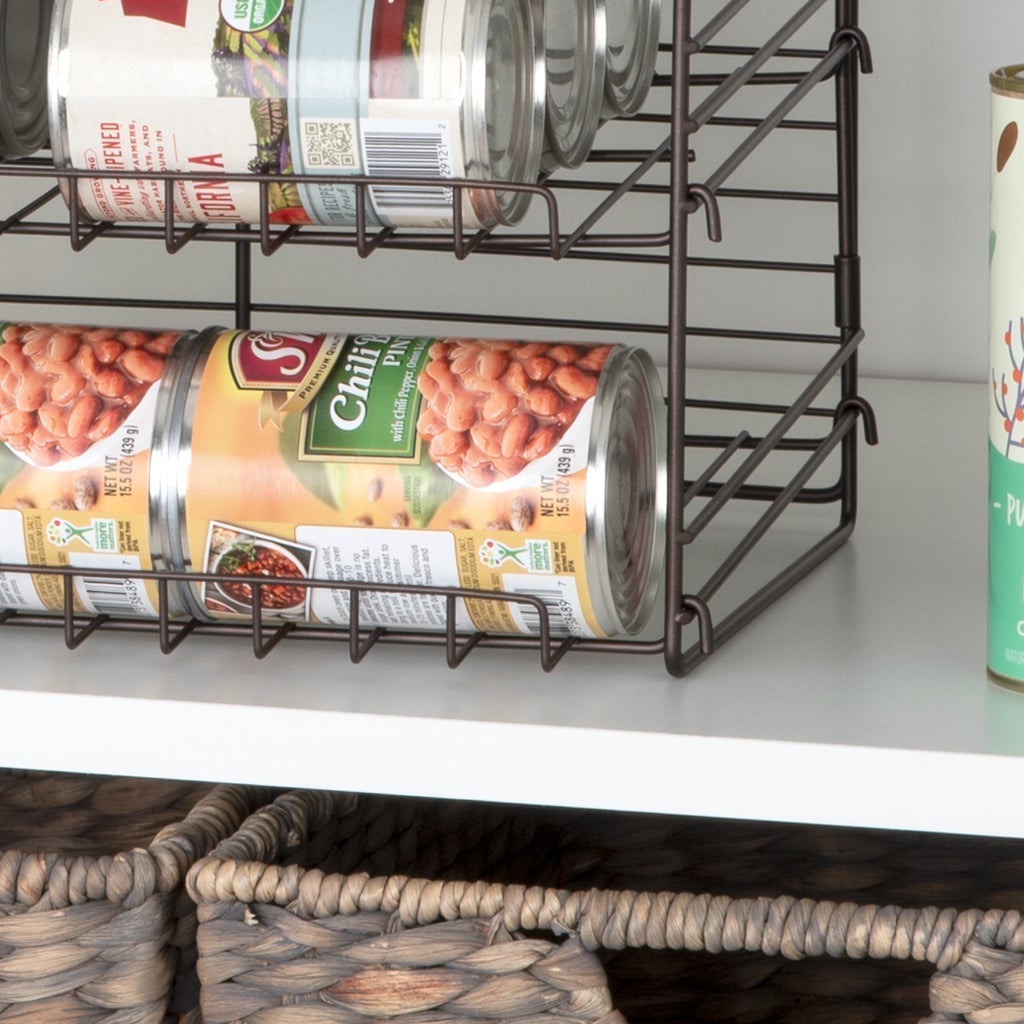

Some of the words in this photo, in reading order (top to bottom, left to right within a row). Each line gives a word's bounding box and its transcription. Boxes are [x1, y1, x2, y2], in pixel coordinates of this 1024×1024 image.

[156, 130, 163, 141] IN
[299, 359, 332, 399] PREMIUM
[329, 347, 382, 431] Chili
[393, 397, 408, 422] Chili
[126, 424, 139, 436] g)
[391, 422, 404, 443] with
[120, 437, 136, 458] (439
[560, 443, 575, 455] g)
[105, 456, 118, 474] WT
[119, 461, 133, 477] OZ
[557, 457, 572, 478] (439
[104, 476, 117, 497] NET
[119, 477, 132, 497] 15.5
[541, 475, 554, 495] WT
[556, 481, 570, 496] OZ
[541, 496, 554, 517] NET
[556, 496, 569, 517] 15.5
[98, 521, 109, 550] more
[532, 542, 543, 571] more
